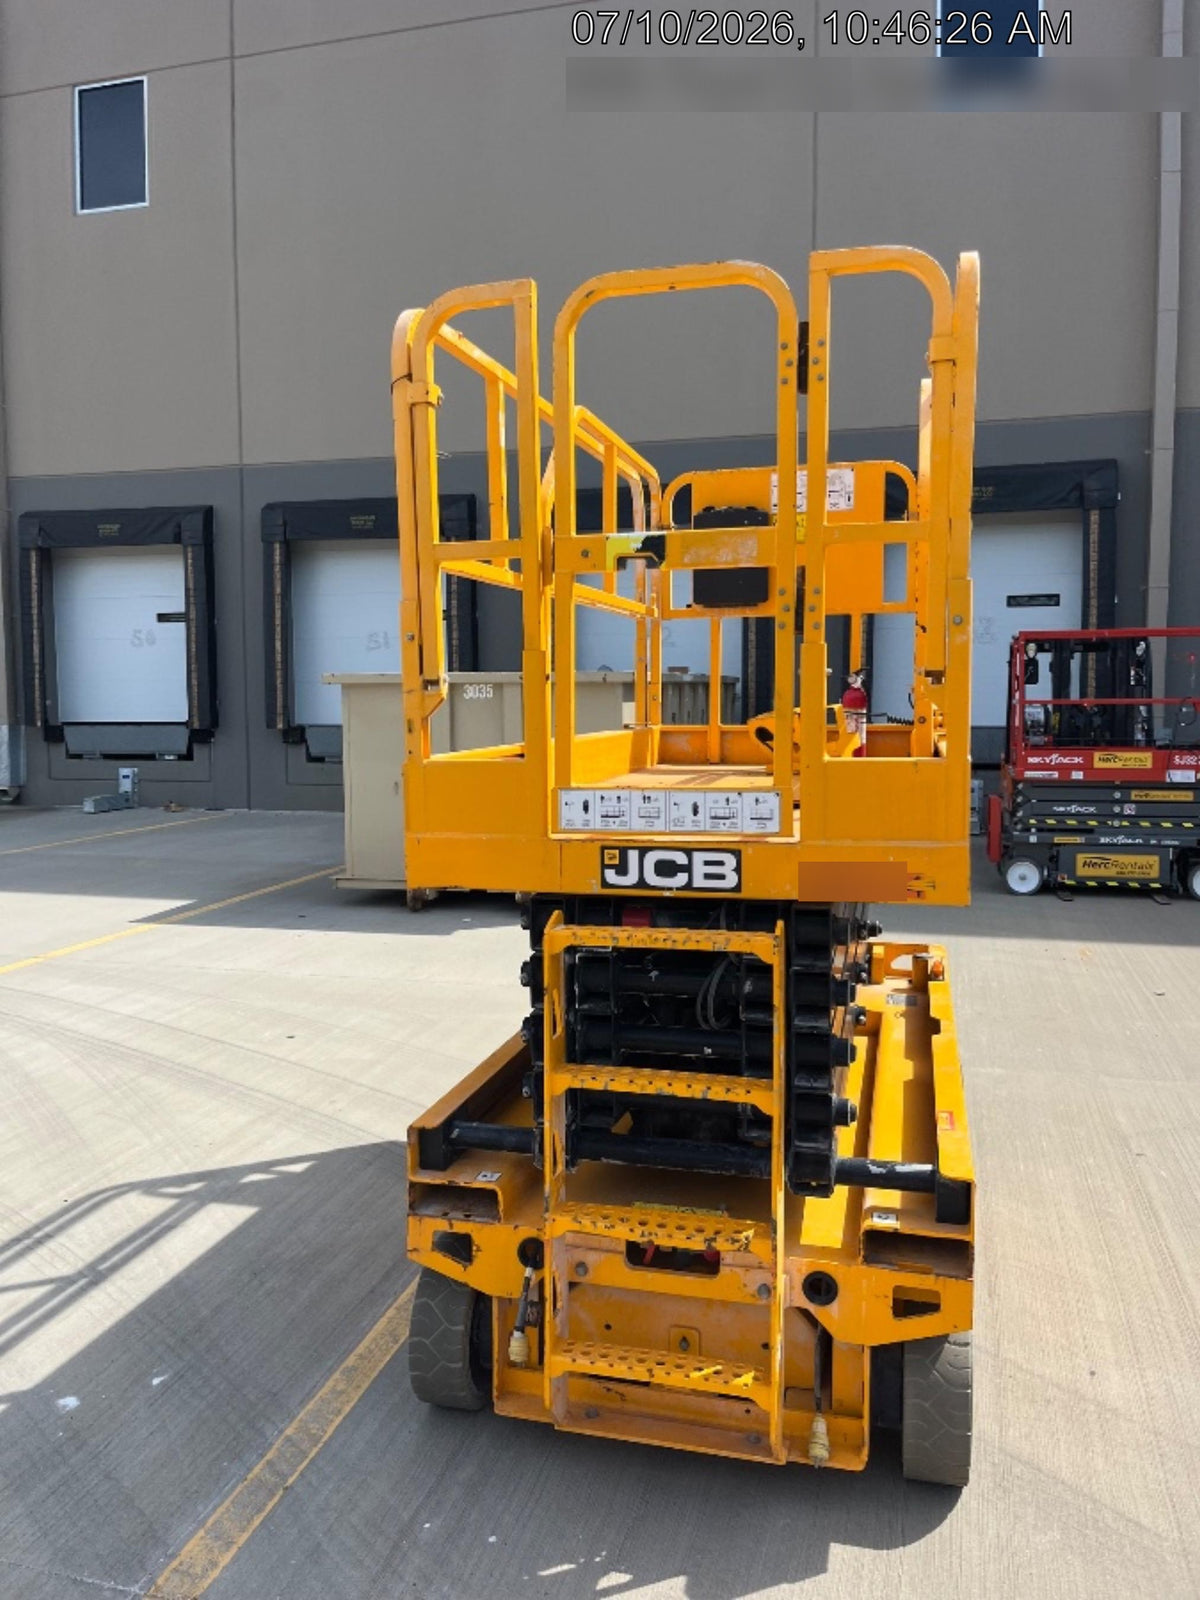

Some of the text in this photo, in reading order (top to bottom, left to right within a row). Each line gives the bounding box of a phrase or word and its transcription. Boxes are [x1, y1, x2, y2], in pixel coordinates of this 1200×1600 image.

[463, 684, 494, 699] 3035
[1027, 754, 1084, 765] SKYJACK
[603, 849, 739, 889] JCB
